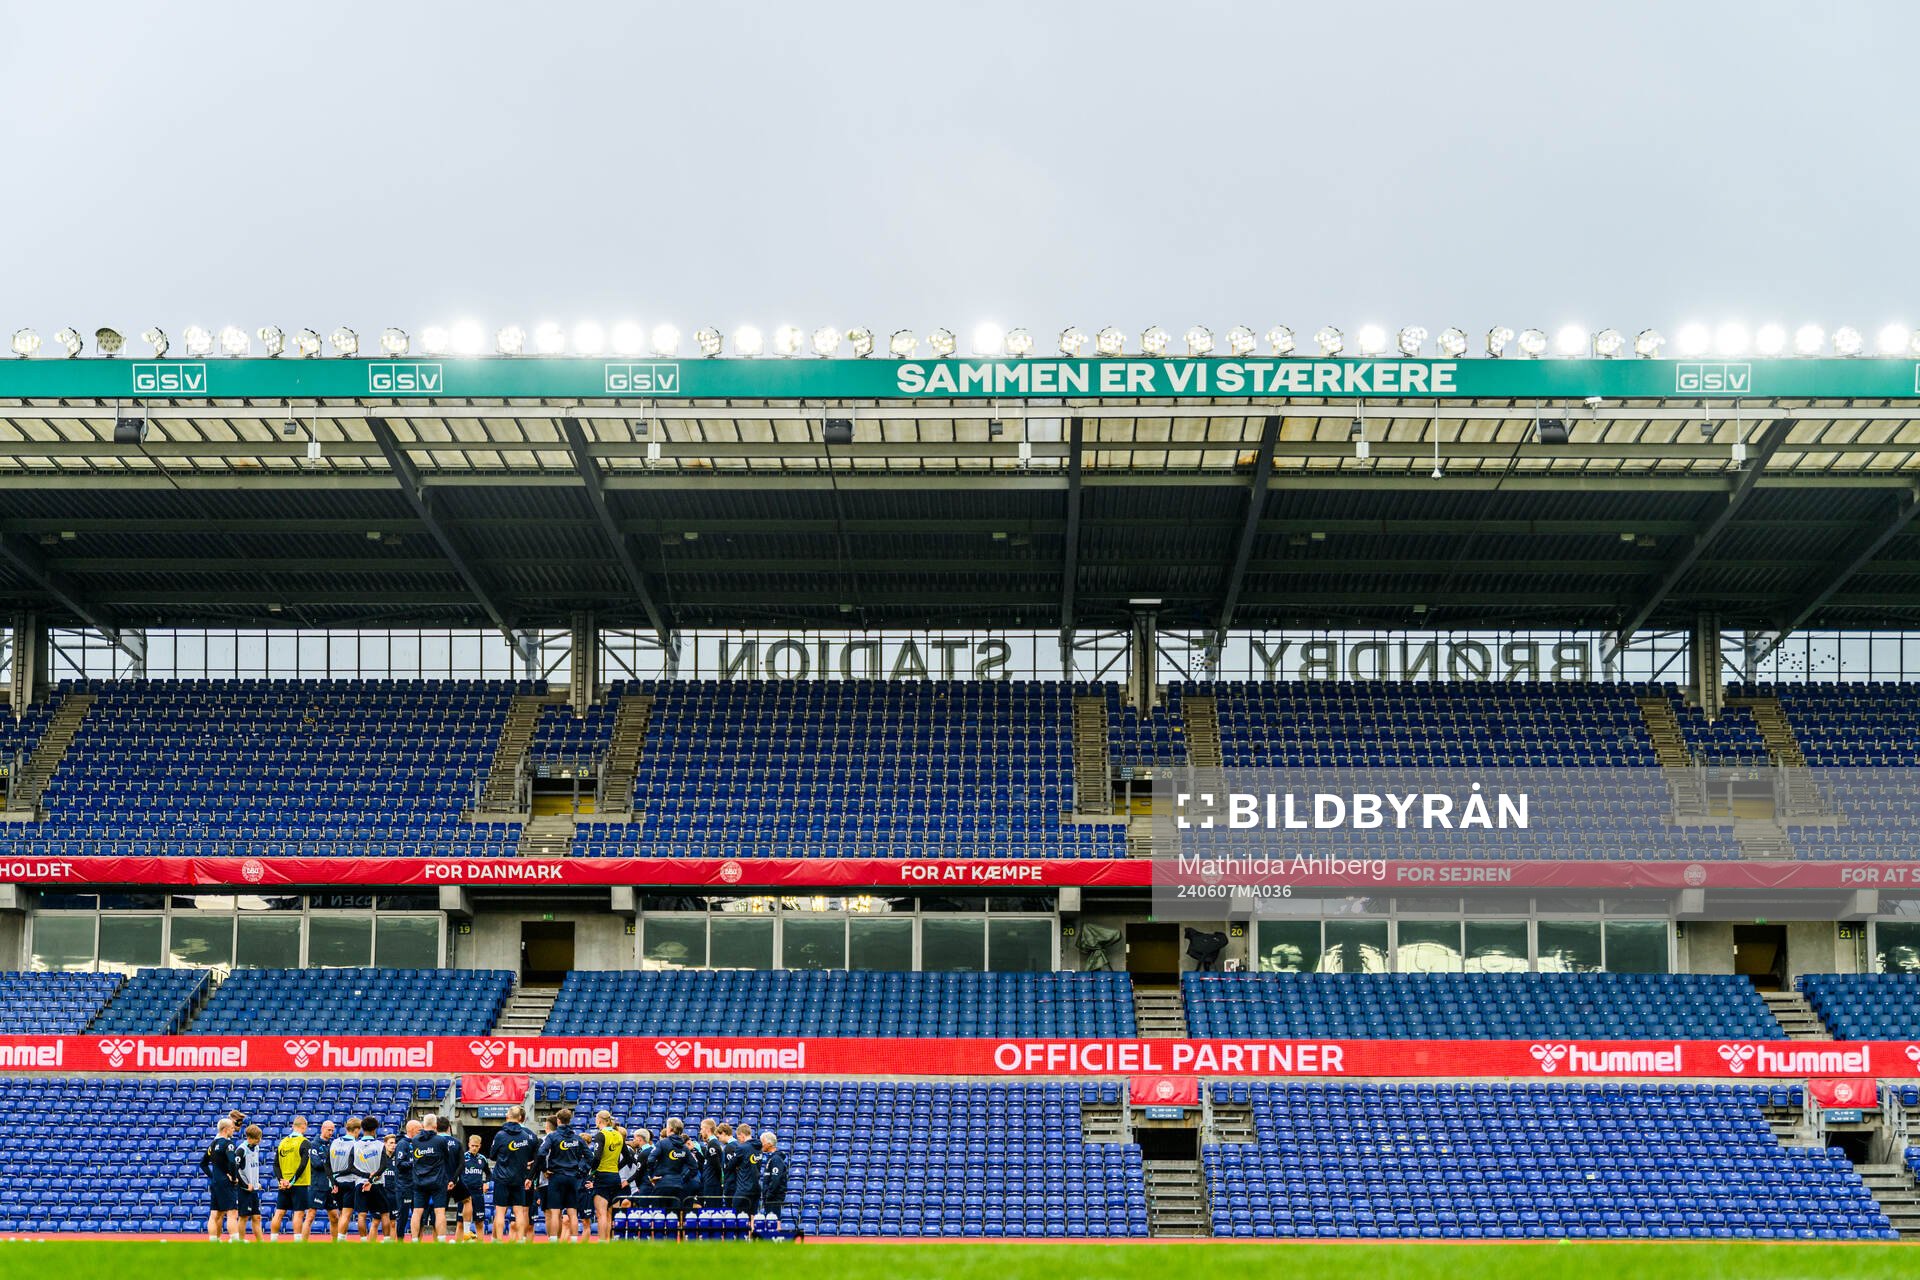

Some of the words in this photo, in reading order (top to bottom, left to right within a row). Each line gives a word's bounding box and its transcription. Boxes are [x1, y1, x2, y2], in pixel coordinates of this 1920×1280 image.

[137, 373, 202, 389] GSV
[372, 373, 438, 389] GSV
[609, 373, 675, 390] GSV
[897, 362, 1089, 393] SAMMEN
[1099, 362, 1156, 393] ER
[1163, 362, 1207, 393] VI
[1215, 362, 1457, 393] STÆRKERE
[1679, 373, 1747, 389] GSV
[578, 769, 589, 777] 19
[1161, 770, 1173, 778] 20
[1748, 772, 1759, 780] 21
[0, 863, 72, 877] HOLDET
[425, 864, 463, 879] FOR
[468, 864, 563, 879] DANMARK
[901, 865, 940, 880] FOR
[943, 865, 968, 880] AT
[971, 865, 1043, 880] KÆMPE
[1396, 867, 1435, 882] FOR
[1439, 867, 1511, 882] SEJREN
[1841, 868, 1880, 883] FOR
[1883, 868, 1908, 883] AT
[459, 926, 470, 934] 19
[1063, 928, 1074, 936] 20
[1231, 928, 1243, 937] 20
[1840, 930, 1851, 938] 21
[137, 1040, 248, 1067] hummel
[322, 1040, 434, 1068] hummel
[508, 1041, 619, 1068] hummel
[693, 1041, 805, 1069] hummel
[993, 1043, 1163, 1071] OFFICIEL
[1172, 1044, 1344, 1072] PARTNER
[1569, 1045, 1682, 1072] hummel
[1757, 1045, 1870, 1073] hummel
